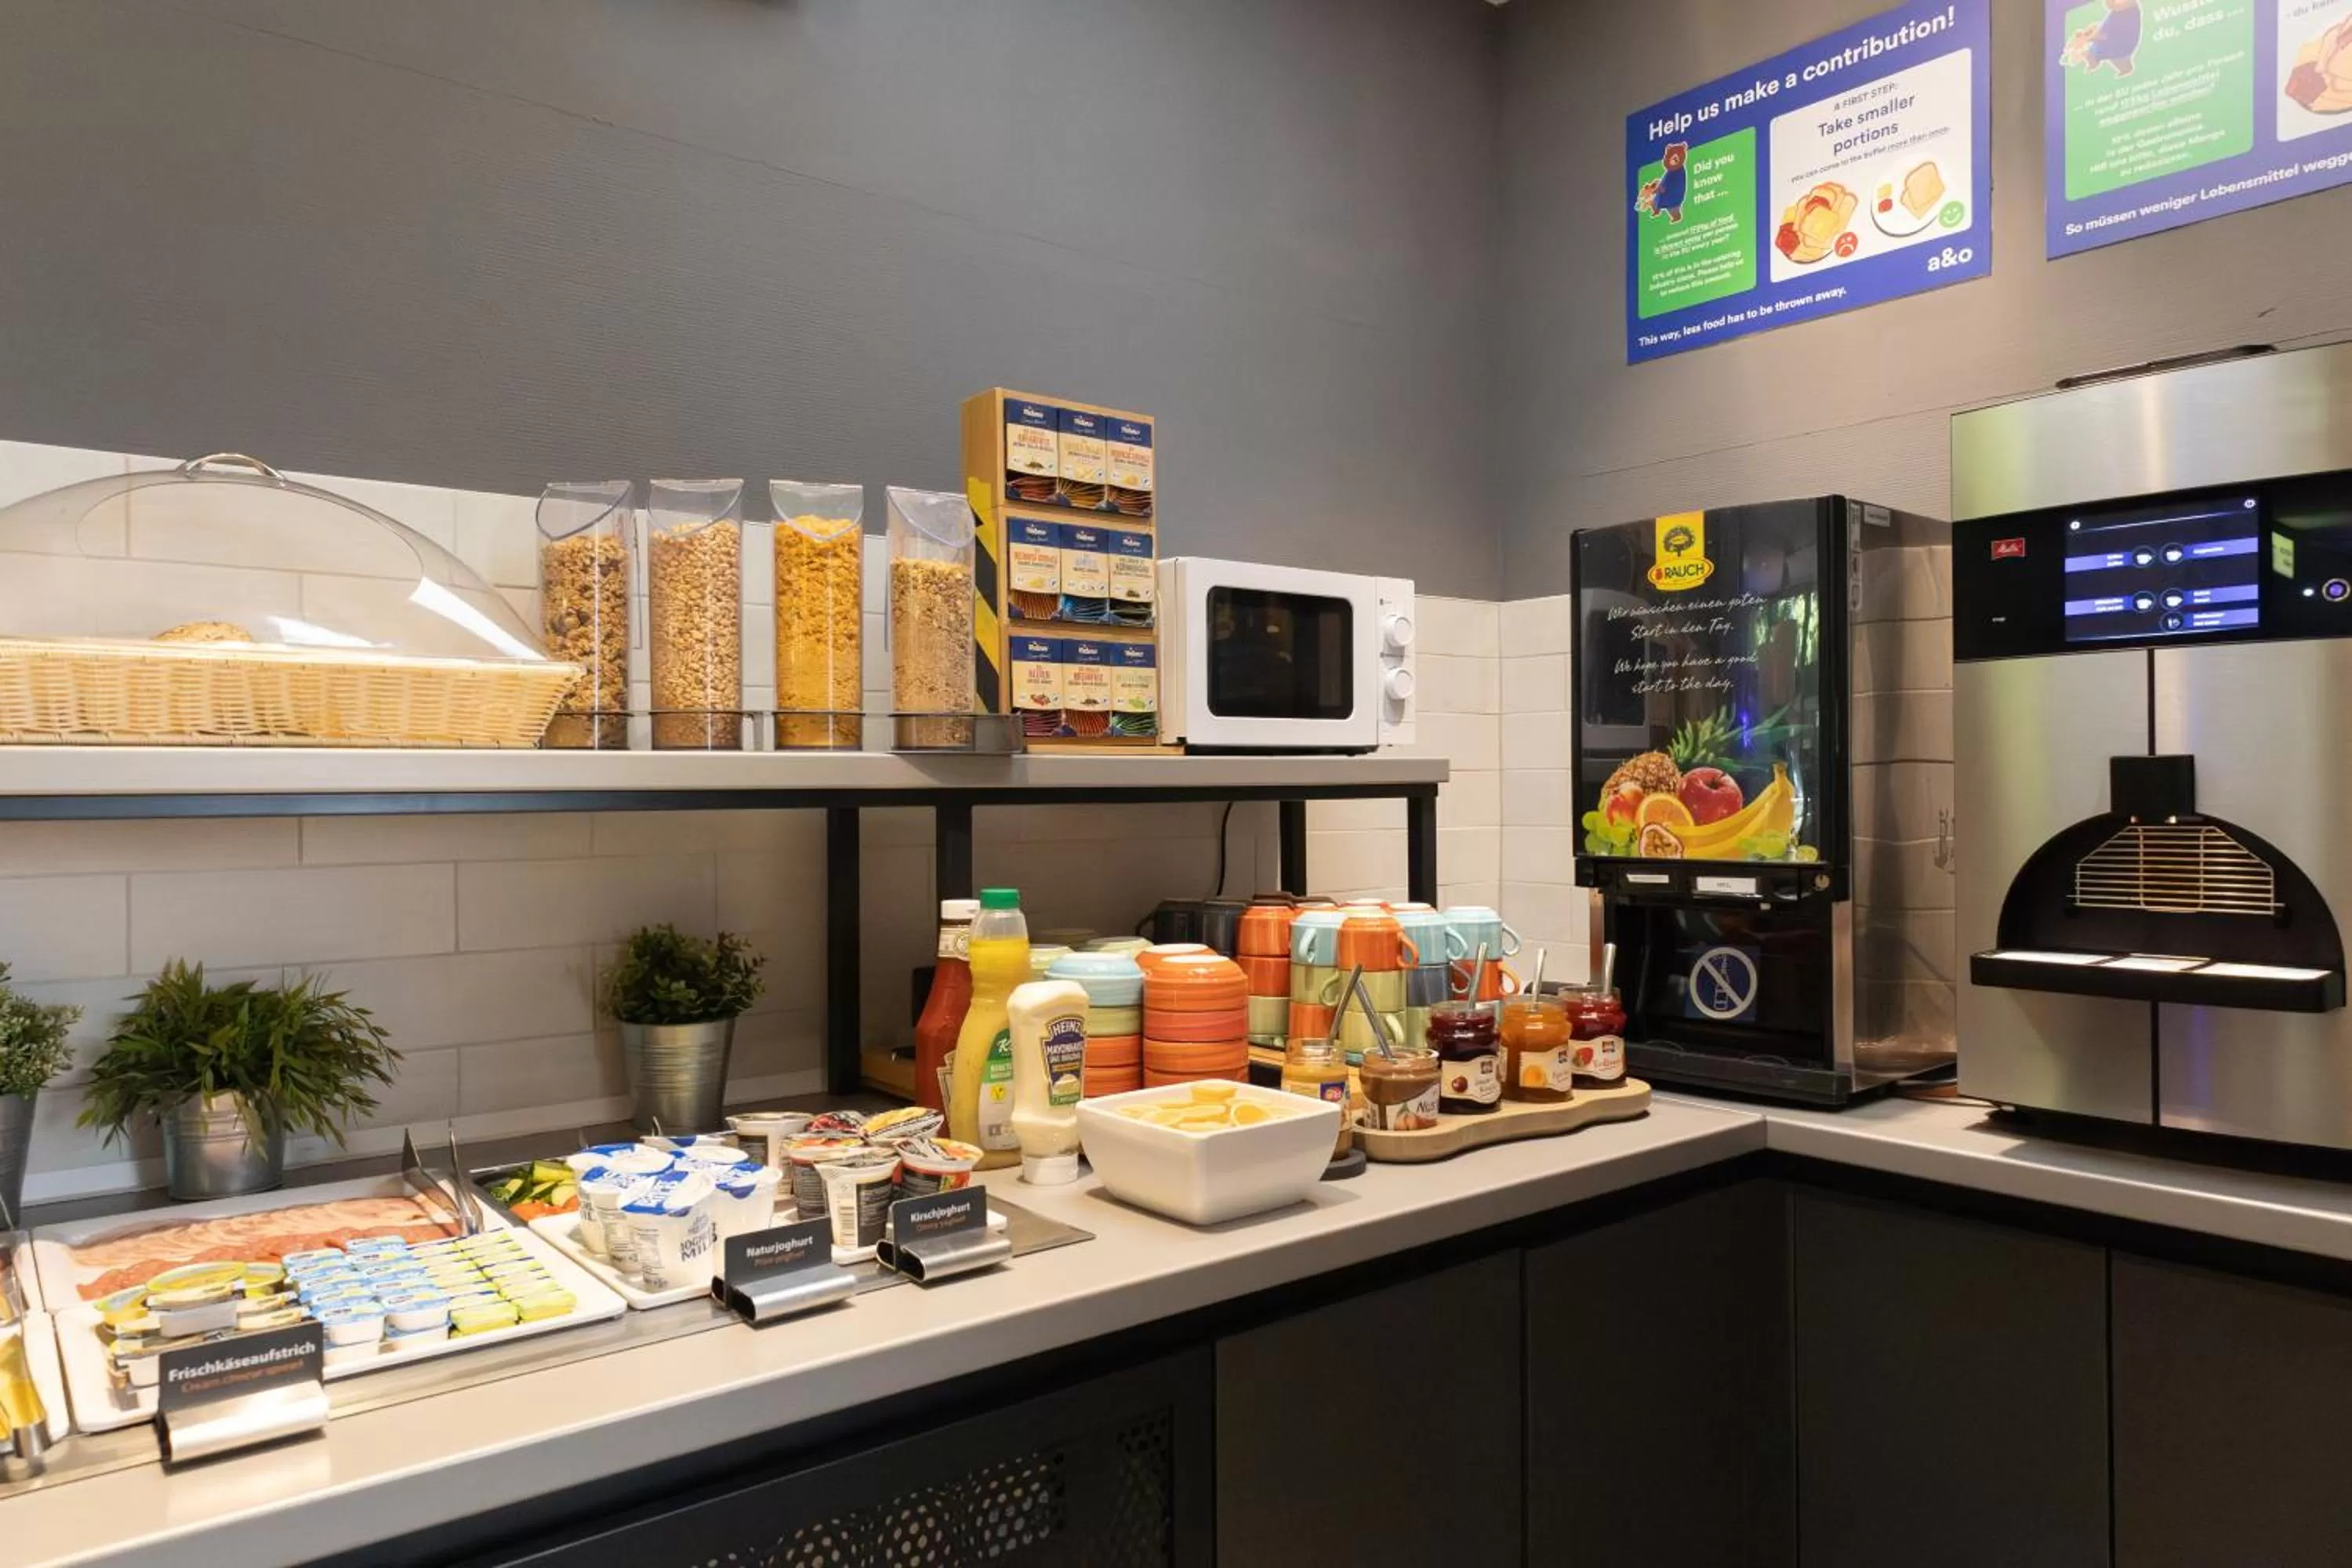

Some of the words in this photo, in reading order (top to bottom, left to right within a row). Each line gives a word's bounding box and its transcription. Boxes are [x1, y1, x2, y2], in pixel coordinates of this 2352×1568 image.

[1648, 112, 1693, 141] Help
[1697, 102, 1720, 122] us
[1725, 78, 1780, 113] make
[1784, 72, 1798, 89] a
[1802, 5, 1955, 82] contribution!
[1842, 92, 1870, 108] FIRST
[1817, 117, 1853, 138] Take
[1857, 94, 1916, 125] smaller
[1832, 122, 1900, 156] portions
[1693, 161, 1712, 175] Did
[1715, 153, 1735, 170] you
[1693, 172, 1724, 191] know
[1693, 191, 1715, 205] that
[2065, 223, 2083, 236] So
[2085, 209, 2137, 231] müssen
[2140, 192, 2197, 217] weniger
[2200, 163, 2300, 201] Lebensmittel
[1927, 246, 1973, 272] a&o
[1638, 334, 1658, 347] This
[1660, 328, 1682, 343] way,
[1682, 322, 1701, 336] less
[1703, 316, 1726, 332] food
[1727, 312, 1745, 325] has
[1746, 309, 1759, 320] to
[1759, 304, 1773, 317] be
[1774, 296, 1814, 313] thrown
[1815, 285, 1847, 303] away.
[1664, 563, 1704, 579] RAUCH
[1630, 623, 1663, 642] Start
[1681, 621, 1706, 633] den
[1708, 617, 1735, 634] Tag.
[1613, 657, 1632, 674] We
[1633, 658, 1659, 675] hope
[1661, 659, 1680, 673] you
[1680, 652, 1713, 668] have
[1631, 678, 1662, 694] start
[1662, 677, 1679, 691] to
[1679, 677, 1705, 691] the
[1705, 676, 1735, 694] day.
[1052, 1019, 1081, 1036] HEINZ
[910, 1202, 971, 1223] Kirschjoghurt
[746, 1236, 813, 1258] Naturjoghurt
[168, 1341, 316, 1383] Frischkäseaufstrich
